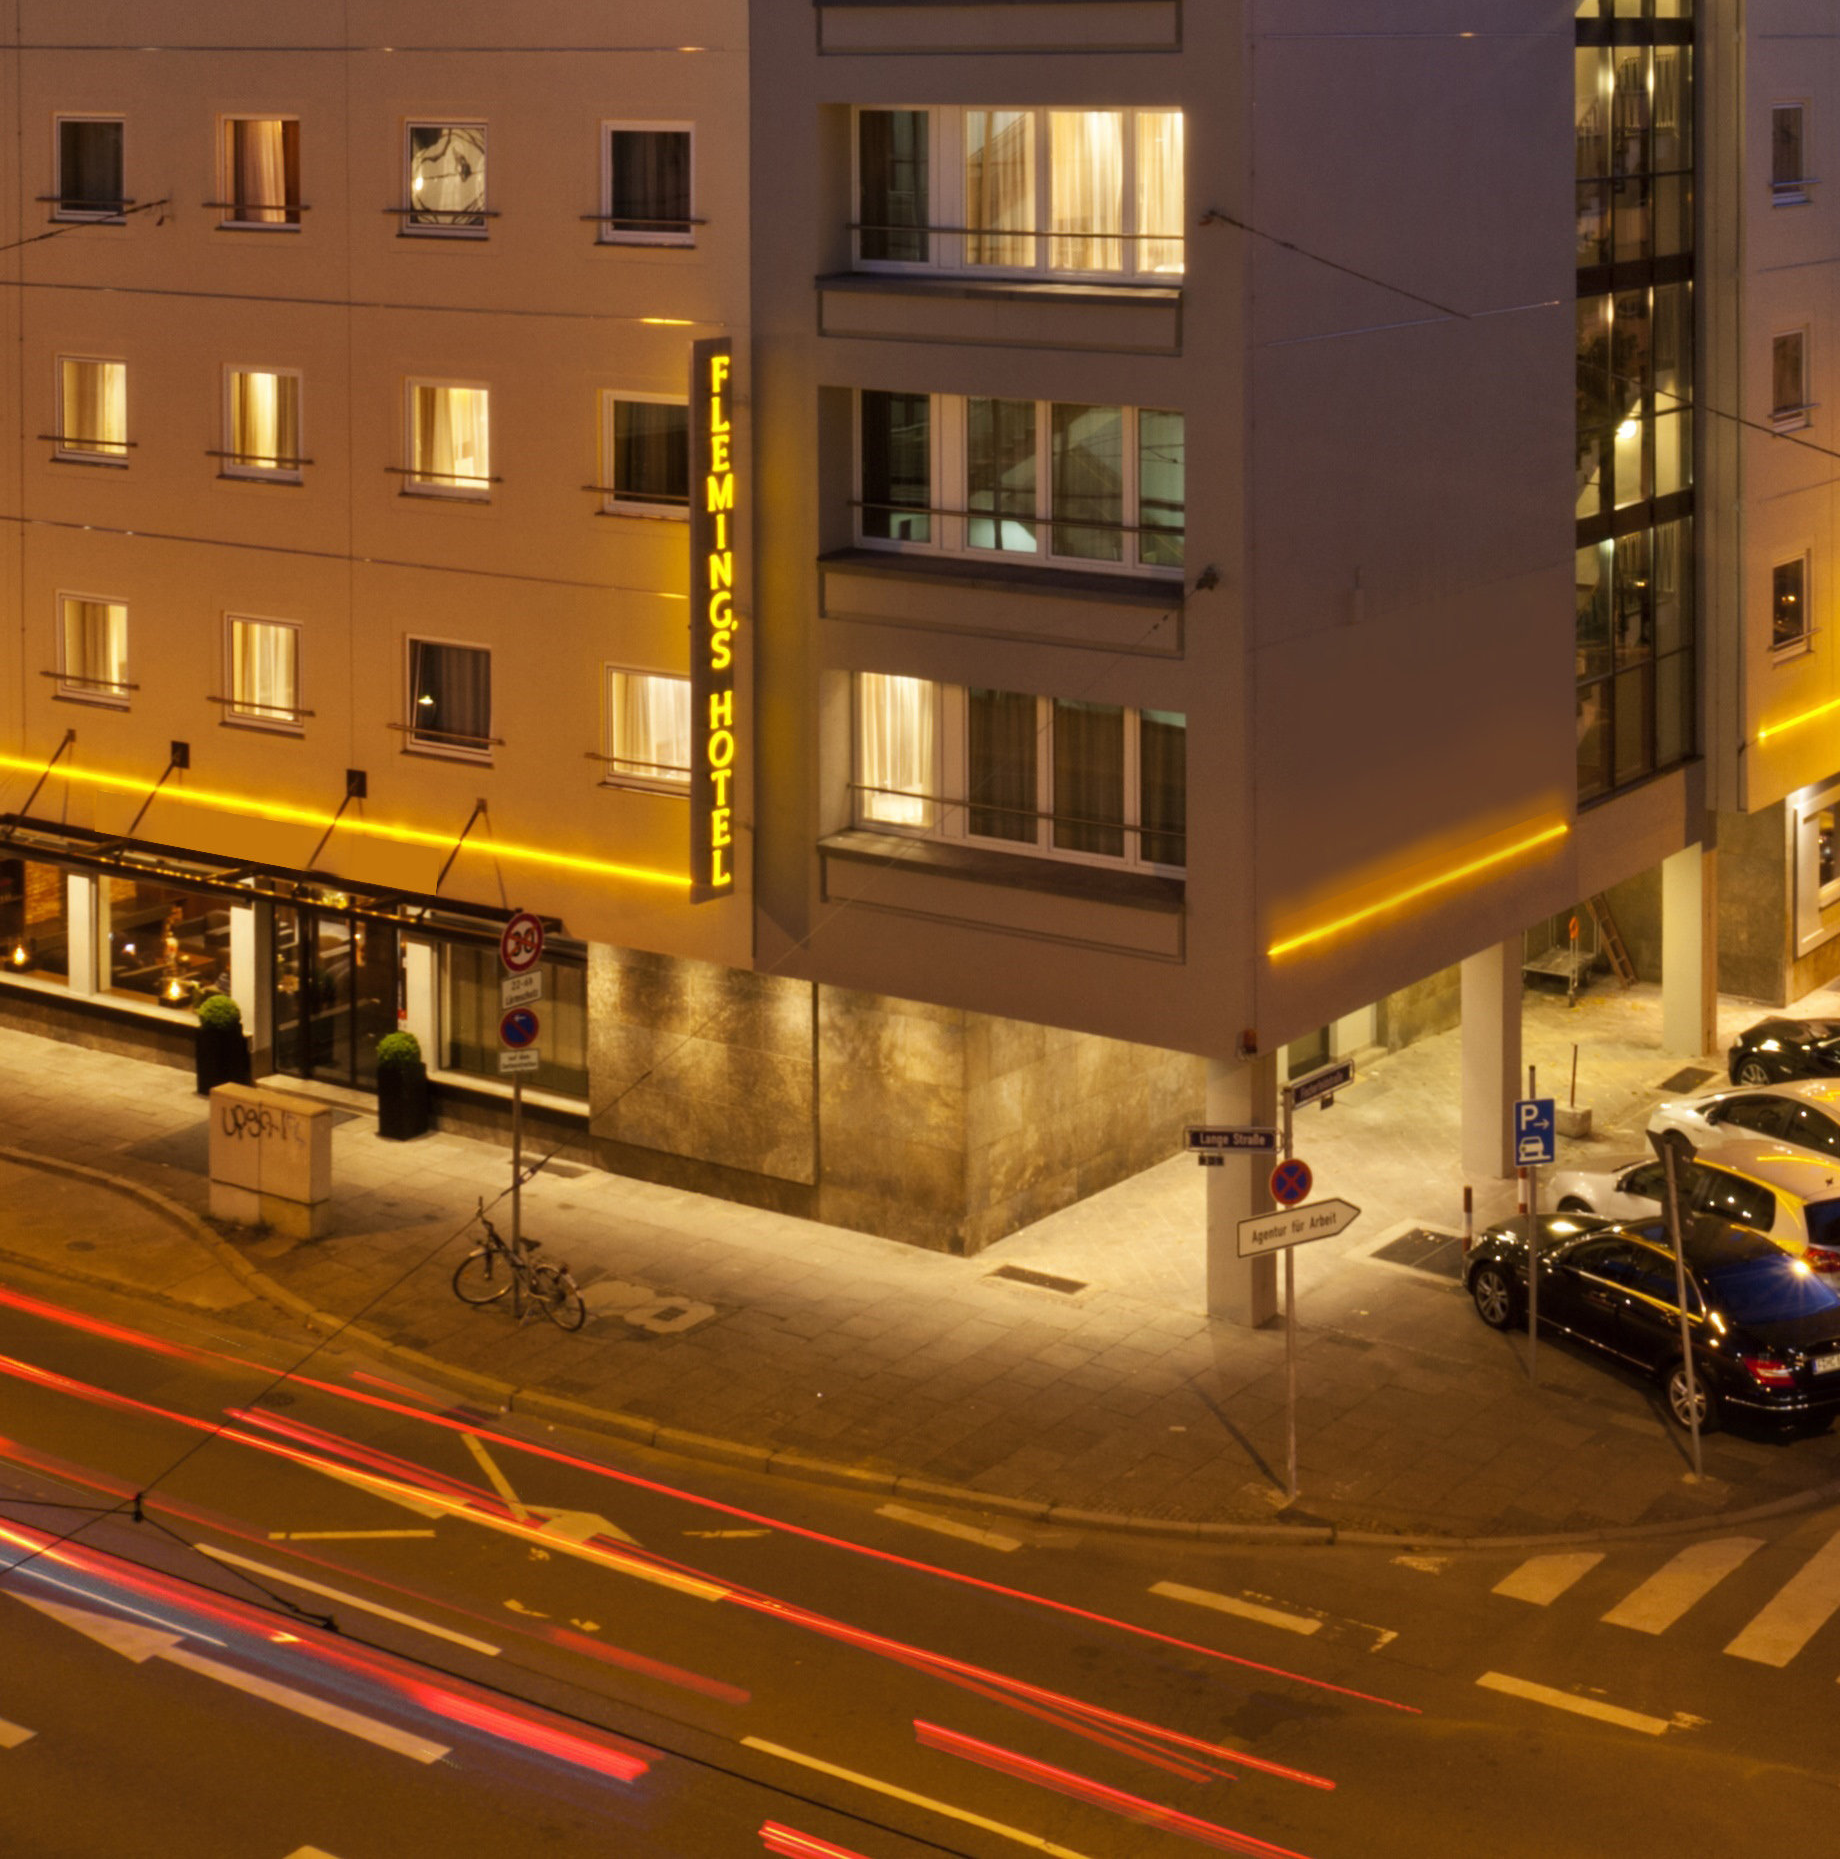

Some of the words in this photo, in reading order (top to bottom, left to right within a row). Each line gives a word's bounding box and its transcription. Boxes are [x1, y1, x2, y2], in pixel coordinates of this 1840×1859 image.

[706, 354, 739, 670] FLEMING'S
[707, 689, 735, 888] HOTEL
[1520, 1103, 1539, 1131] P
[1199, 1133, 1229, 1148] Lange
[1233, 1132, 1266, 1146] Straße
[1251, 1225, 1288, 1245] Agentur
[1291, 1219, 1305, 1234] für
[1309, 1211, 1338, 1228] Arbeit
